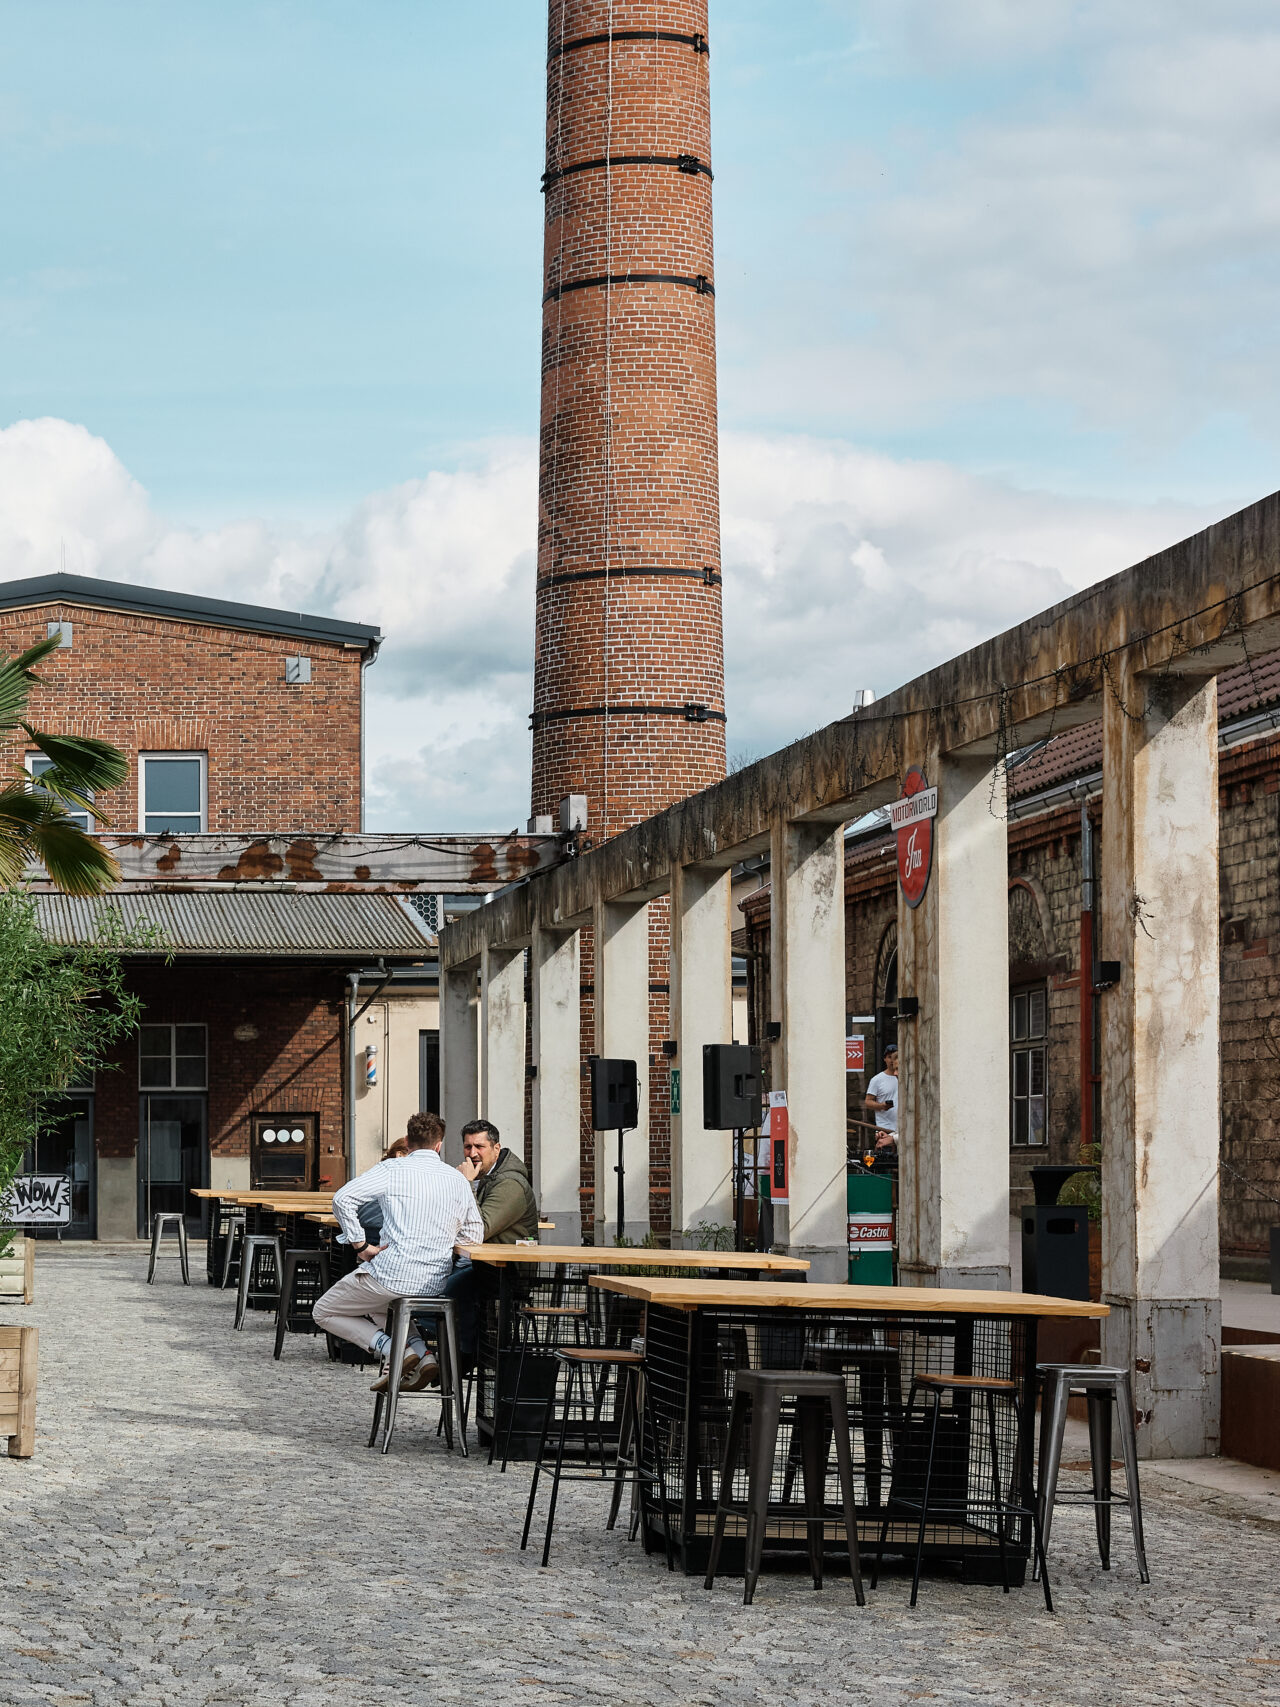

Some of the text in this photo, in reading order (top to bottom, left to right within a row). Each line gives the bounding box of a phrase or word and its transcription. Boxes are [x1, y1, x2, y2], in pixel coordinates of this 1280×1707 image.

[892, 793, 936, 823] MOTORWORLD
[905, 828, 922, 878] Inn
[14, 1180, 60, 1207] WOW
[860, 1226, 889, 1238] Castrol
